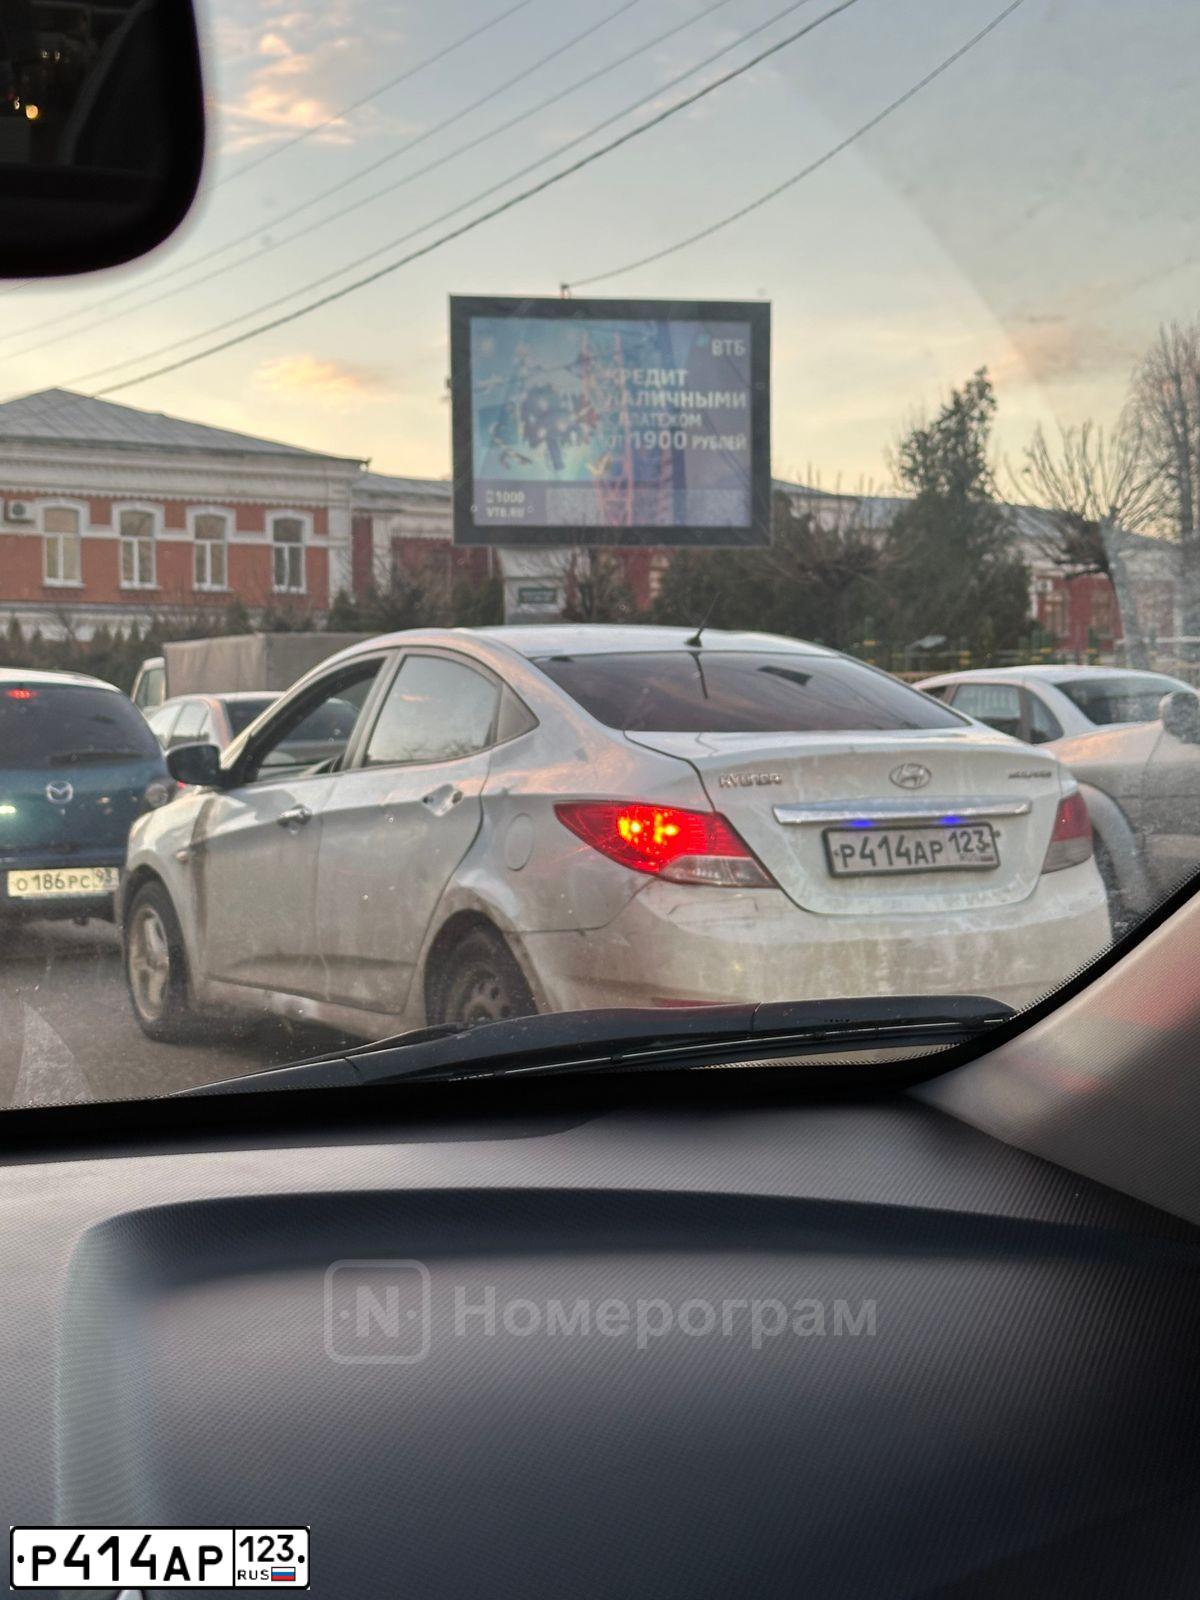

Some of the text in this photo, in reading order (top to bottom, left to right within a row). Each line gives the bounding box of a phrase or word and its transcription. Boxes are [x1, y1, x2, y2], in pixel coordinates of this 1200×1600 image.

[711, 338, 747, 357] ВТБ
[607, 389, 747, 409] АЛИЧНЫМИ
[632, 430, 688, 450] 1900
[839, 830, 985, 868] Р414АР 123
